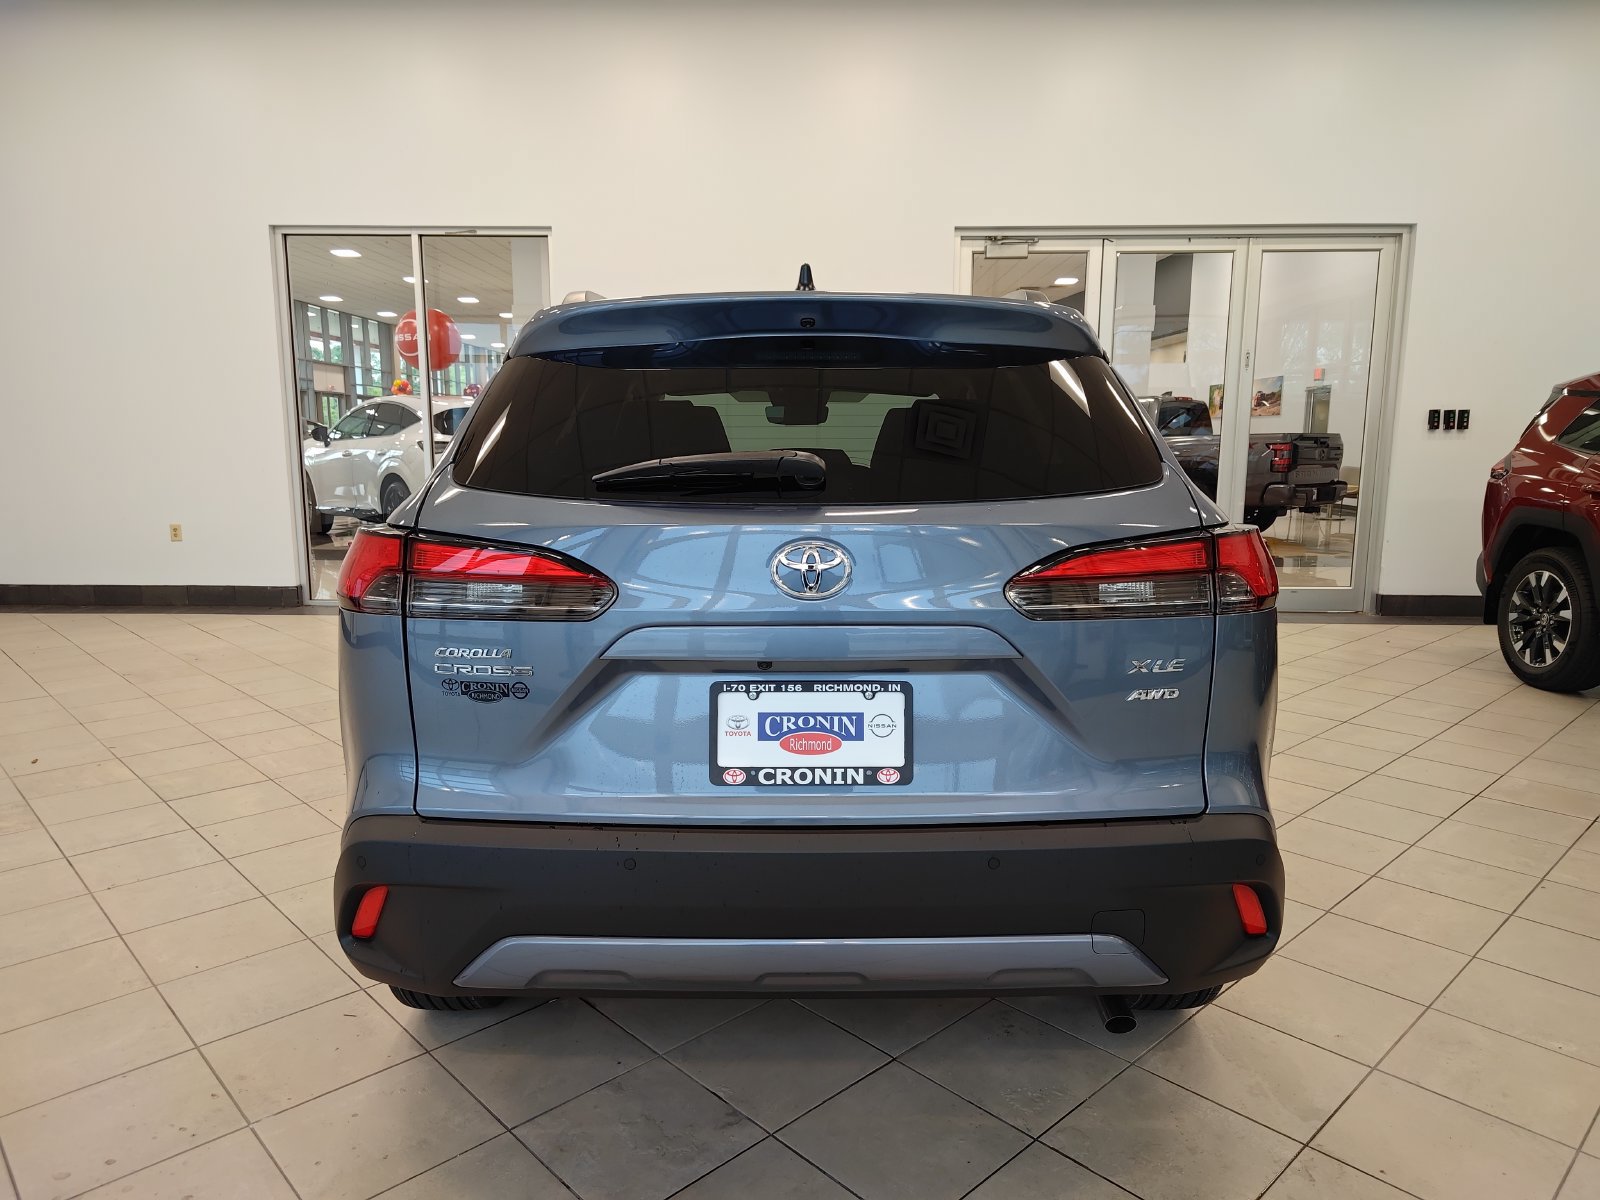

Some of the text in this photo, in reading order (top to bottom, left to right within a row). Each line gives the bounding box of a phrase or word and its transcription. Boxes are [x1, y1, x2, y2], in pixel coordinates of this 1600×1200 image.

[434, 647, 512, 659] COROLLA
[434, 663, 534, 677] CROSS
[1127, 658, 1186, 674] XLE
[462, 681, 509, 694] CRONIN
[723, 684, 901, 692] I-70 EXIT 156 RICHMOND, IN
[1126, 688, 1180, 701] AWD
[764, 715, 857, 737] CRONIN
[789, 738, 832, 751] Richmond
[757, 768, 864, 785] CRONIN
